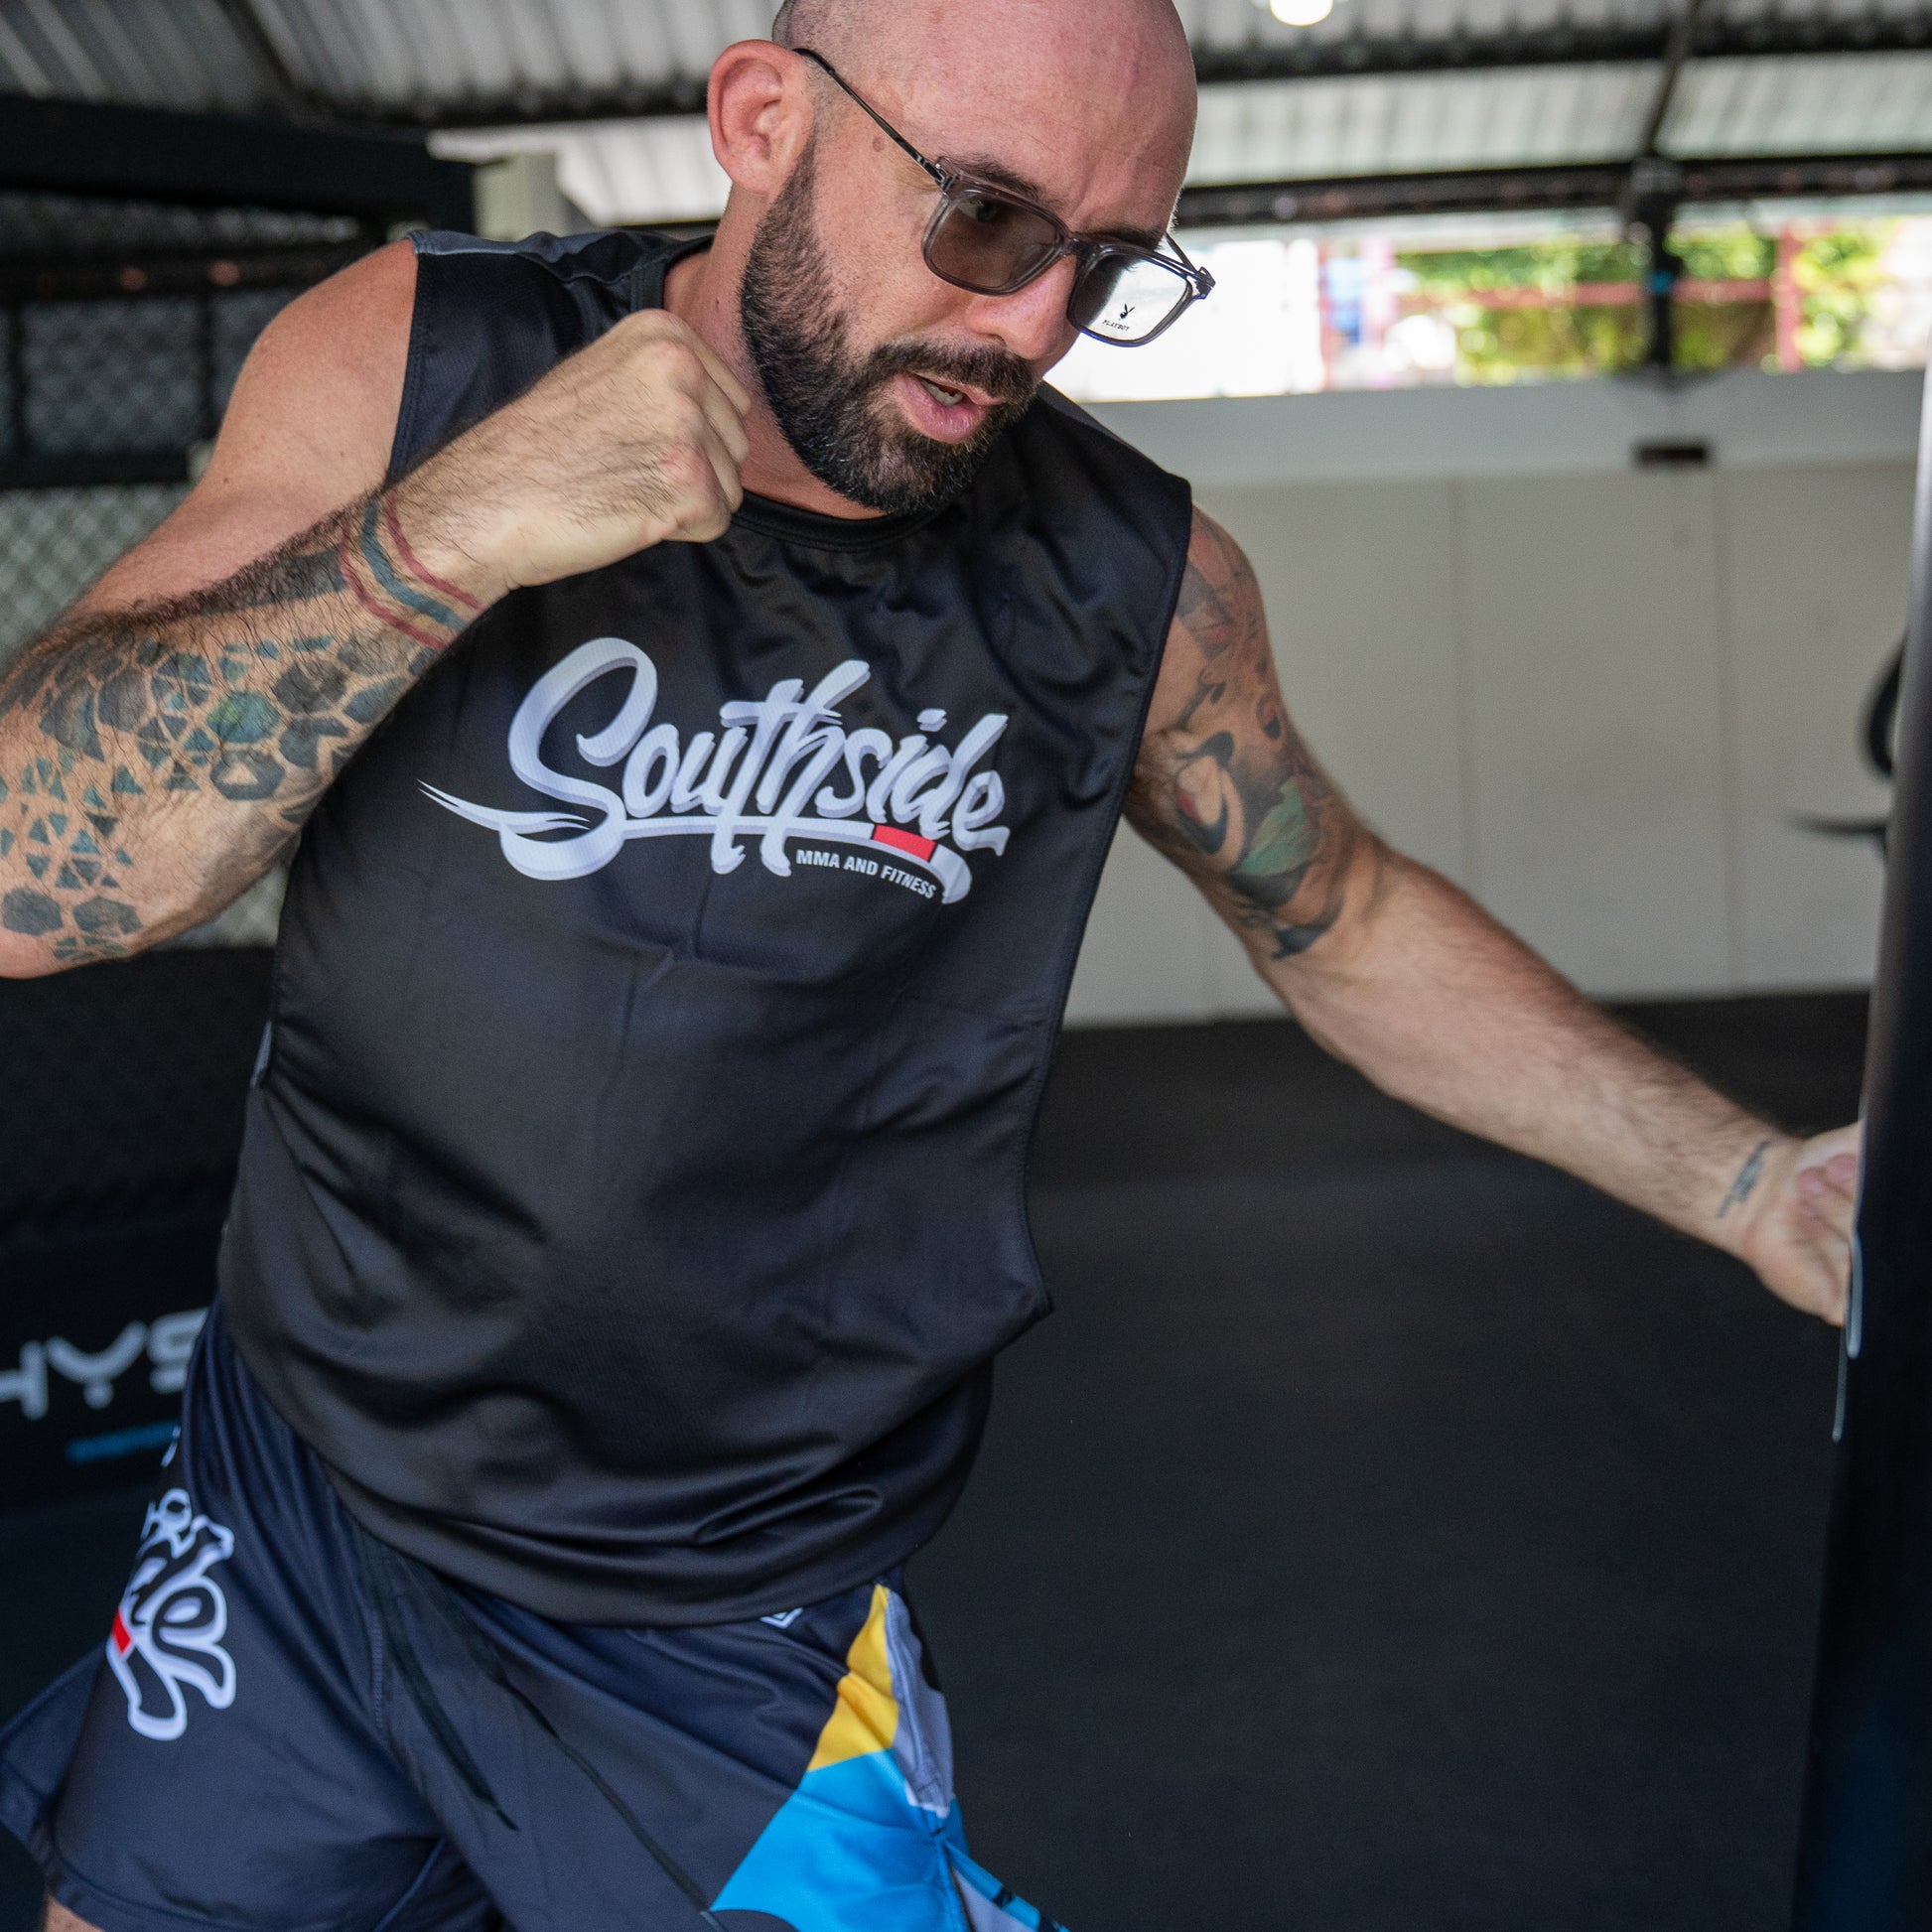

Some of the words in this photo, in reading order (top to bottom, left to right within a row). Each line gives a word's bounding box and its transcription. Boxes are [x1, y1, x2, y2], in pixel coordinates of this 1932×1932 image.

[795, 849, 840, 869] MMA
[843, 855, 879, 876] AND
[880, 864, 937, 899] FITNESS
